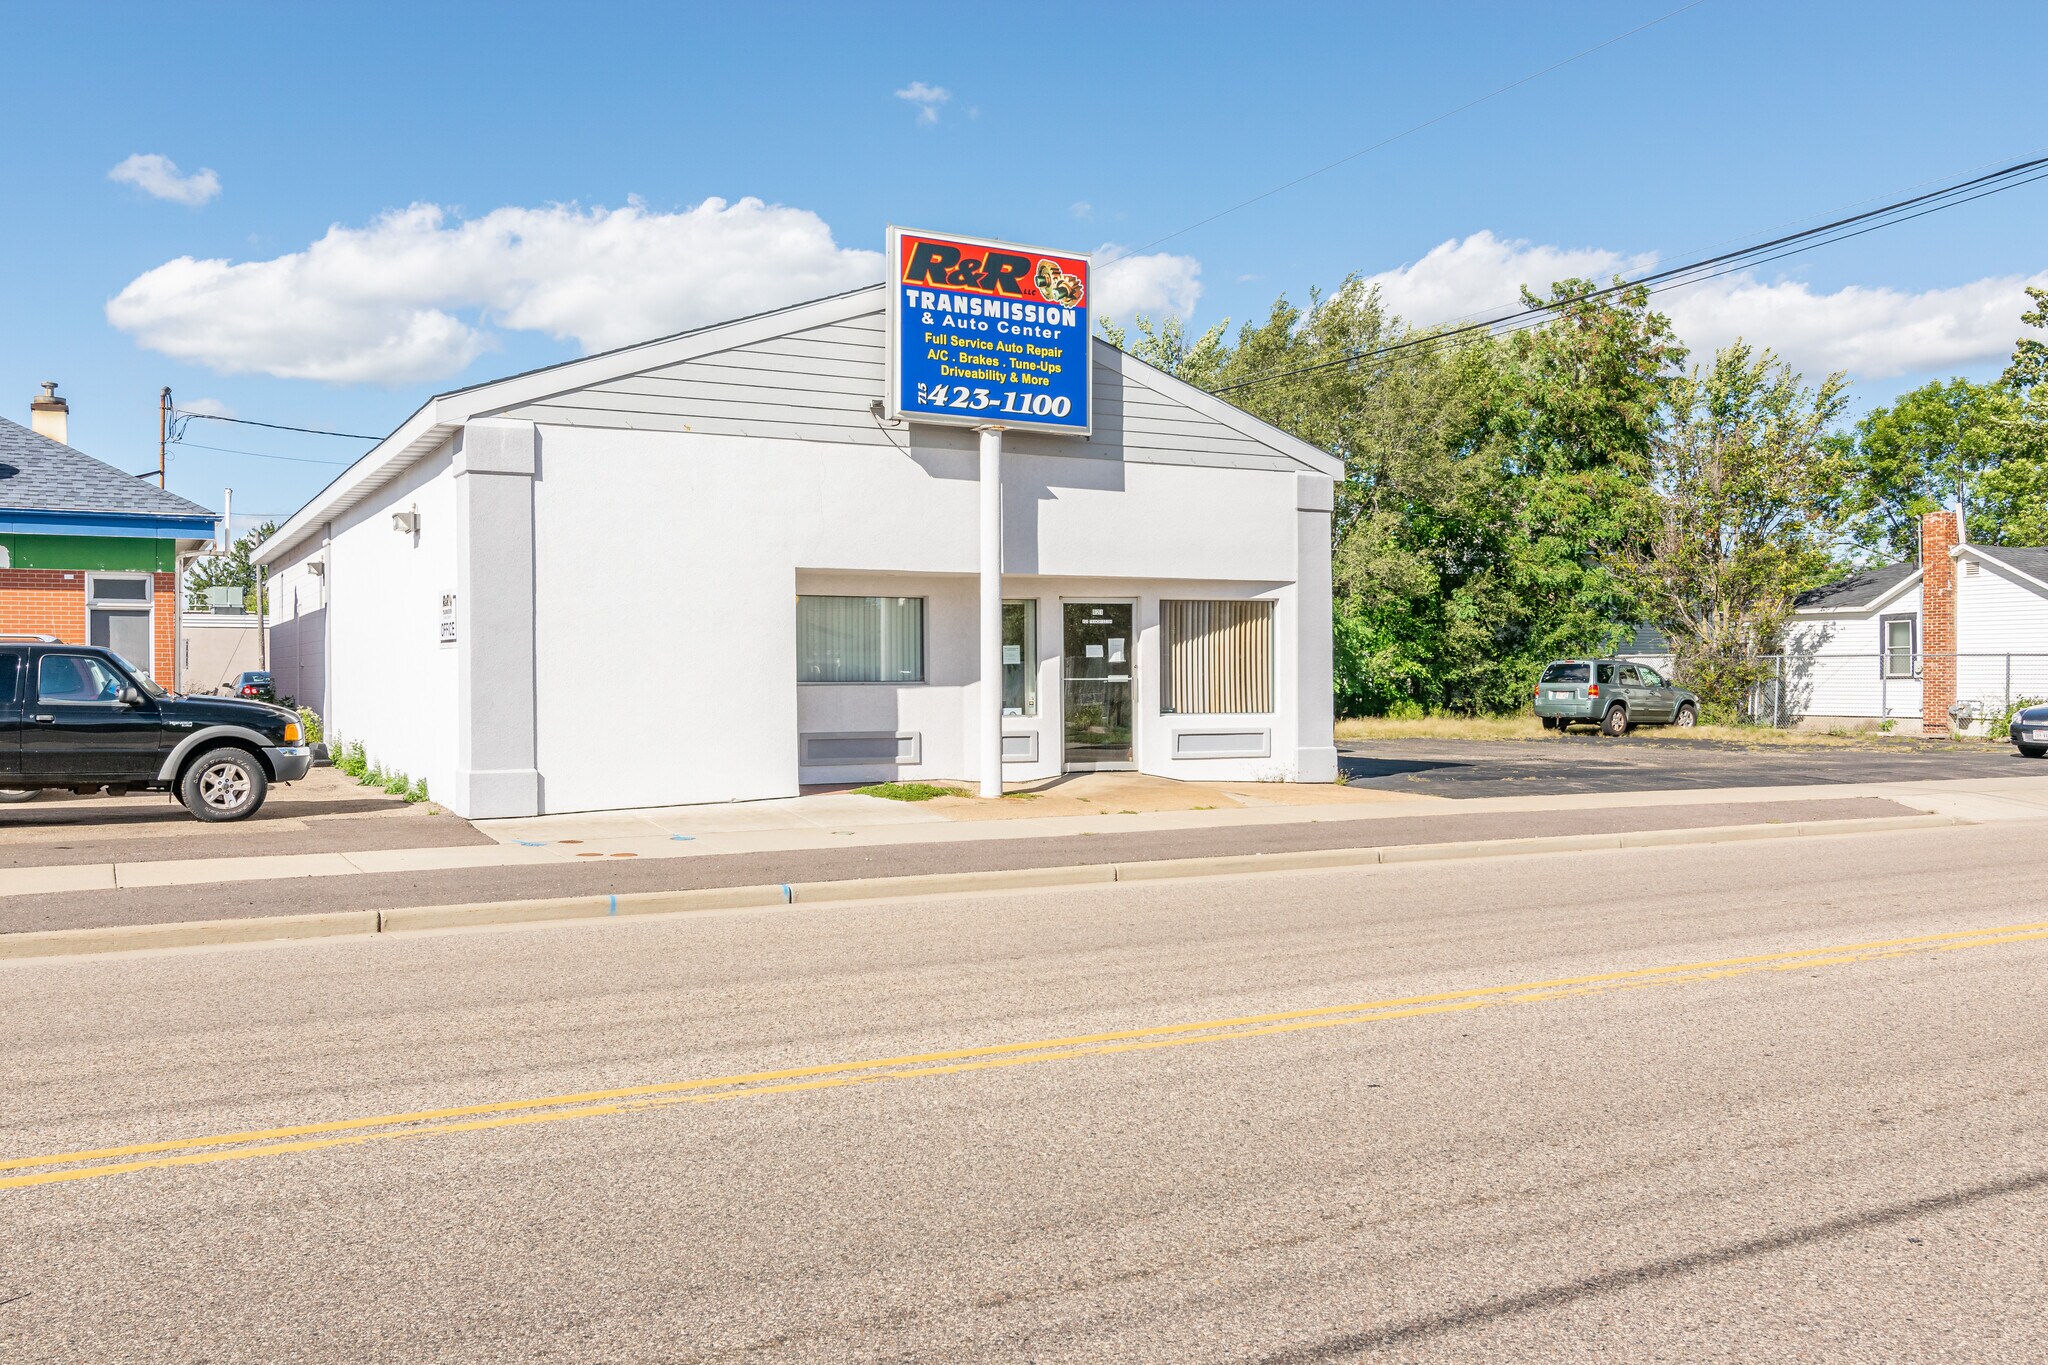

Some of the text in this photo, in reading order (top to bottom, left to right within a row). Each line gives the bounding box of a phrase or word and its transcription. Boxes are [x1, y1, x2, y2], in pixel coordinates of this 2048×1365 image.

[902, 241, 1031, 298] R&R
[1023, 288, 1036, 296] LLC
[906, 289, 1076, 327] TRANSMISSION
[921, 312, 1061, 340] & Auto Center
[924, 332, 1063, 359] Full Service Auto Repair
[927, 348, 949, 361] A/C
[959, 352, 999, 367] Brakes
[1009, 357, 1062, 374] Tune-Ups
[941, 364, 1050, 386] Driveability & More
[917, 382, 1072, 418] 715 423-1100
[440, 621, 455, 637] OFFICE
